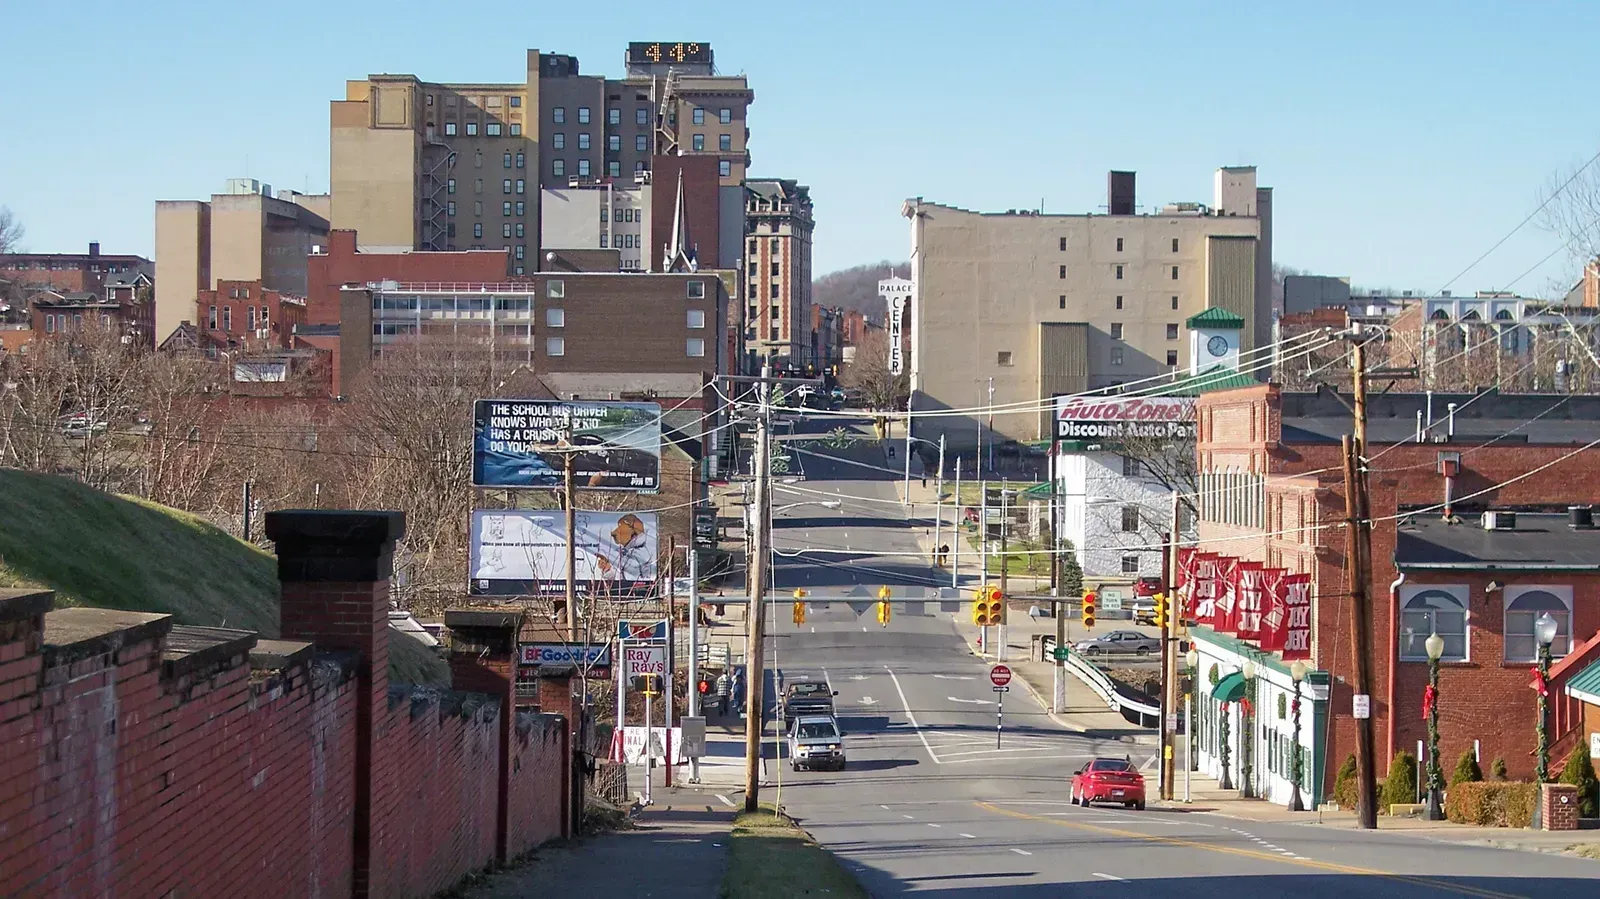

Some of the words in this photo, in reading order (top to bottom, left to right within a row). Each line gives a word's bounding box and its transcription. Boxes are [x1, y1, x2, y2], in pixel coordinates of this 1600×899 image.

[491, 404, 510, 416] THE
[512, 404, 550, 417] SCHOOL
[552, 405, 571, 417] BUS
[573, 406, 608, 418] DRIVER
[490, 416, 527, 428] KNOWS
[529, 416, 552, 428] WHO
[1059, 421, 1123, 437] Discount
[490, 428, 511, 440] HAS
[513, 428, 521, 440] A
[523, 429, 556, 441] CRUSH
[490, 441, 504, 453] DO
[1285, 581, 1310, 605] JOY
[1237, 612, 1262, 632] JOY
[1287, 605, 1311, 628] JOY
[1284, 629, 1310, 651] JOY
[627, 649, 652, 663] Ray
[631, 661, 664, 673] Ray's
